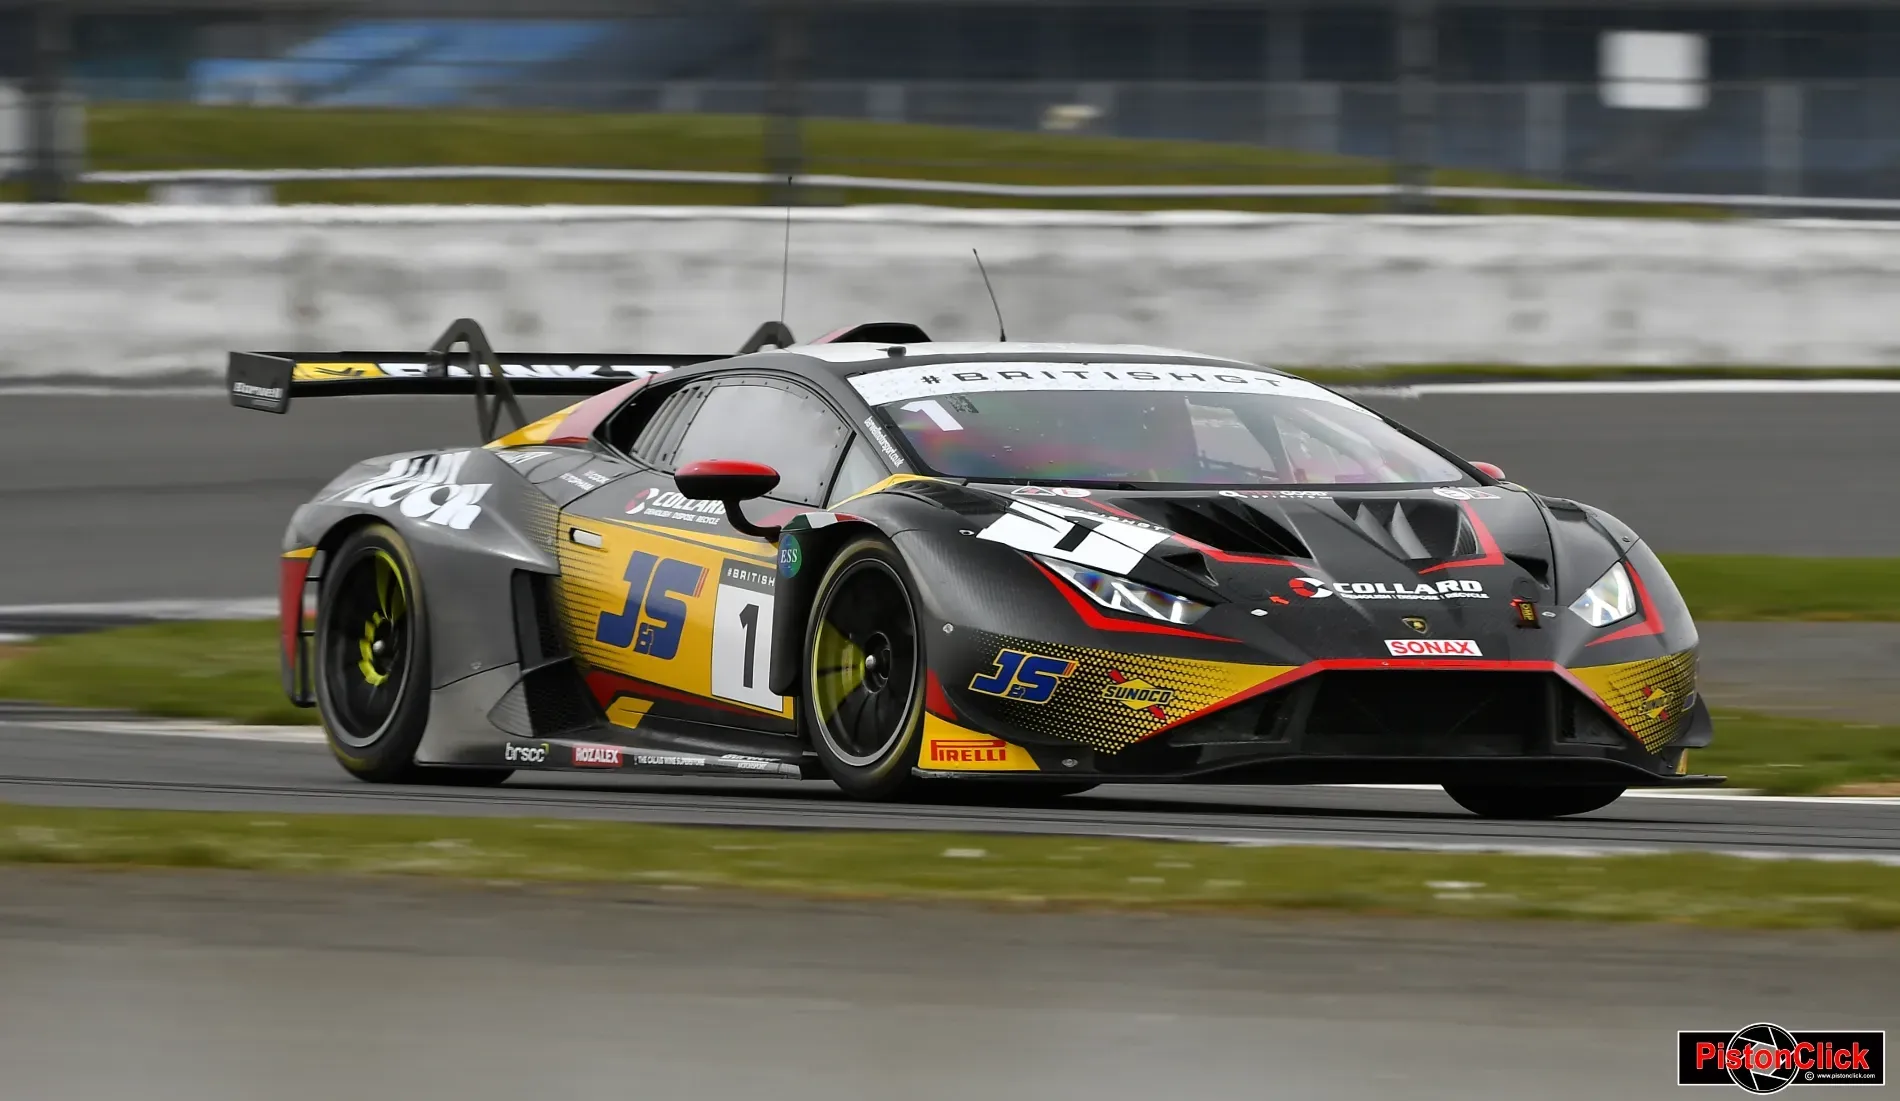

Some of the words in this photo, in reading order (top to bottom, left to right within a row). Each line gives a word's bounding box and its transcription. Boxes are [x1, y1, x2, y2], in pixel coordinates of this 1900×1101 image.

[920, 370, 1283, 388] #BRITISHGT
[900, 400, 964, 431] 1
[1053, 516, 1104, 552] 1
[780, 549, 798, 563] ESS
[1332, 580, 1483, 595] COLLARD
[739, 603, 760, 689] 1
[1391, 641, 1475, 655] SONAX
[1103, 686, 1172, 702] SUNOCO
[505, 742, 546, 762] brscc
[575, 747, 619, 763] ROZALEX
[930, 739, 1007, 761] PIRELLI
